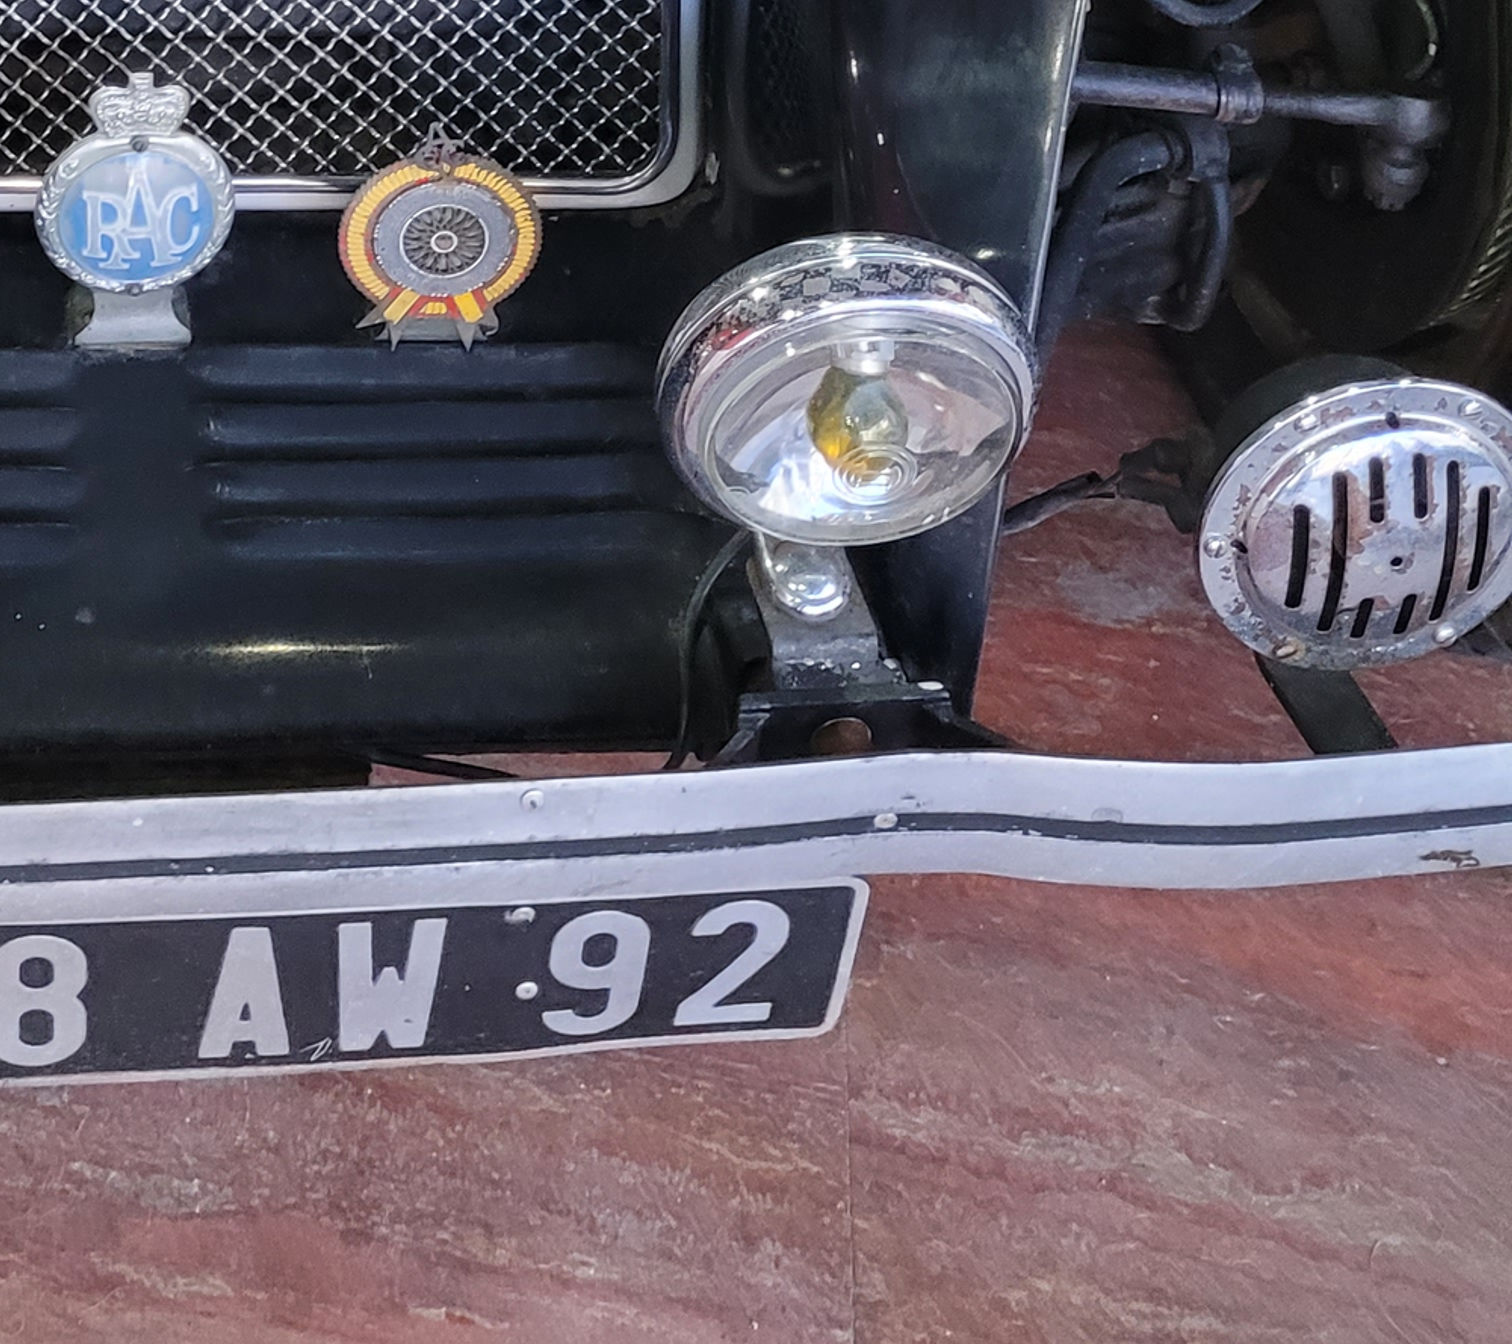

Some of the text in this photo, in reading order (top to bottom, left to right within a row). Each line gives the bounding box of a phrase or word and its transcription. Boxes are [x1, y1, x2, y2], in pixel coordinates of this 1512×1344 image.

[81, 166, 200, 270] RAC
[198, 917, 448, 1060] AW
[542, 899, 791, 1036] 92
